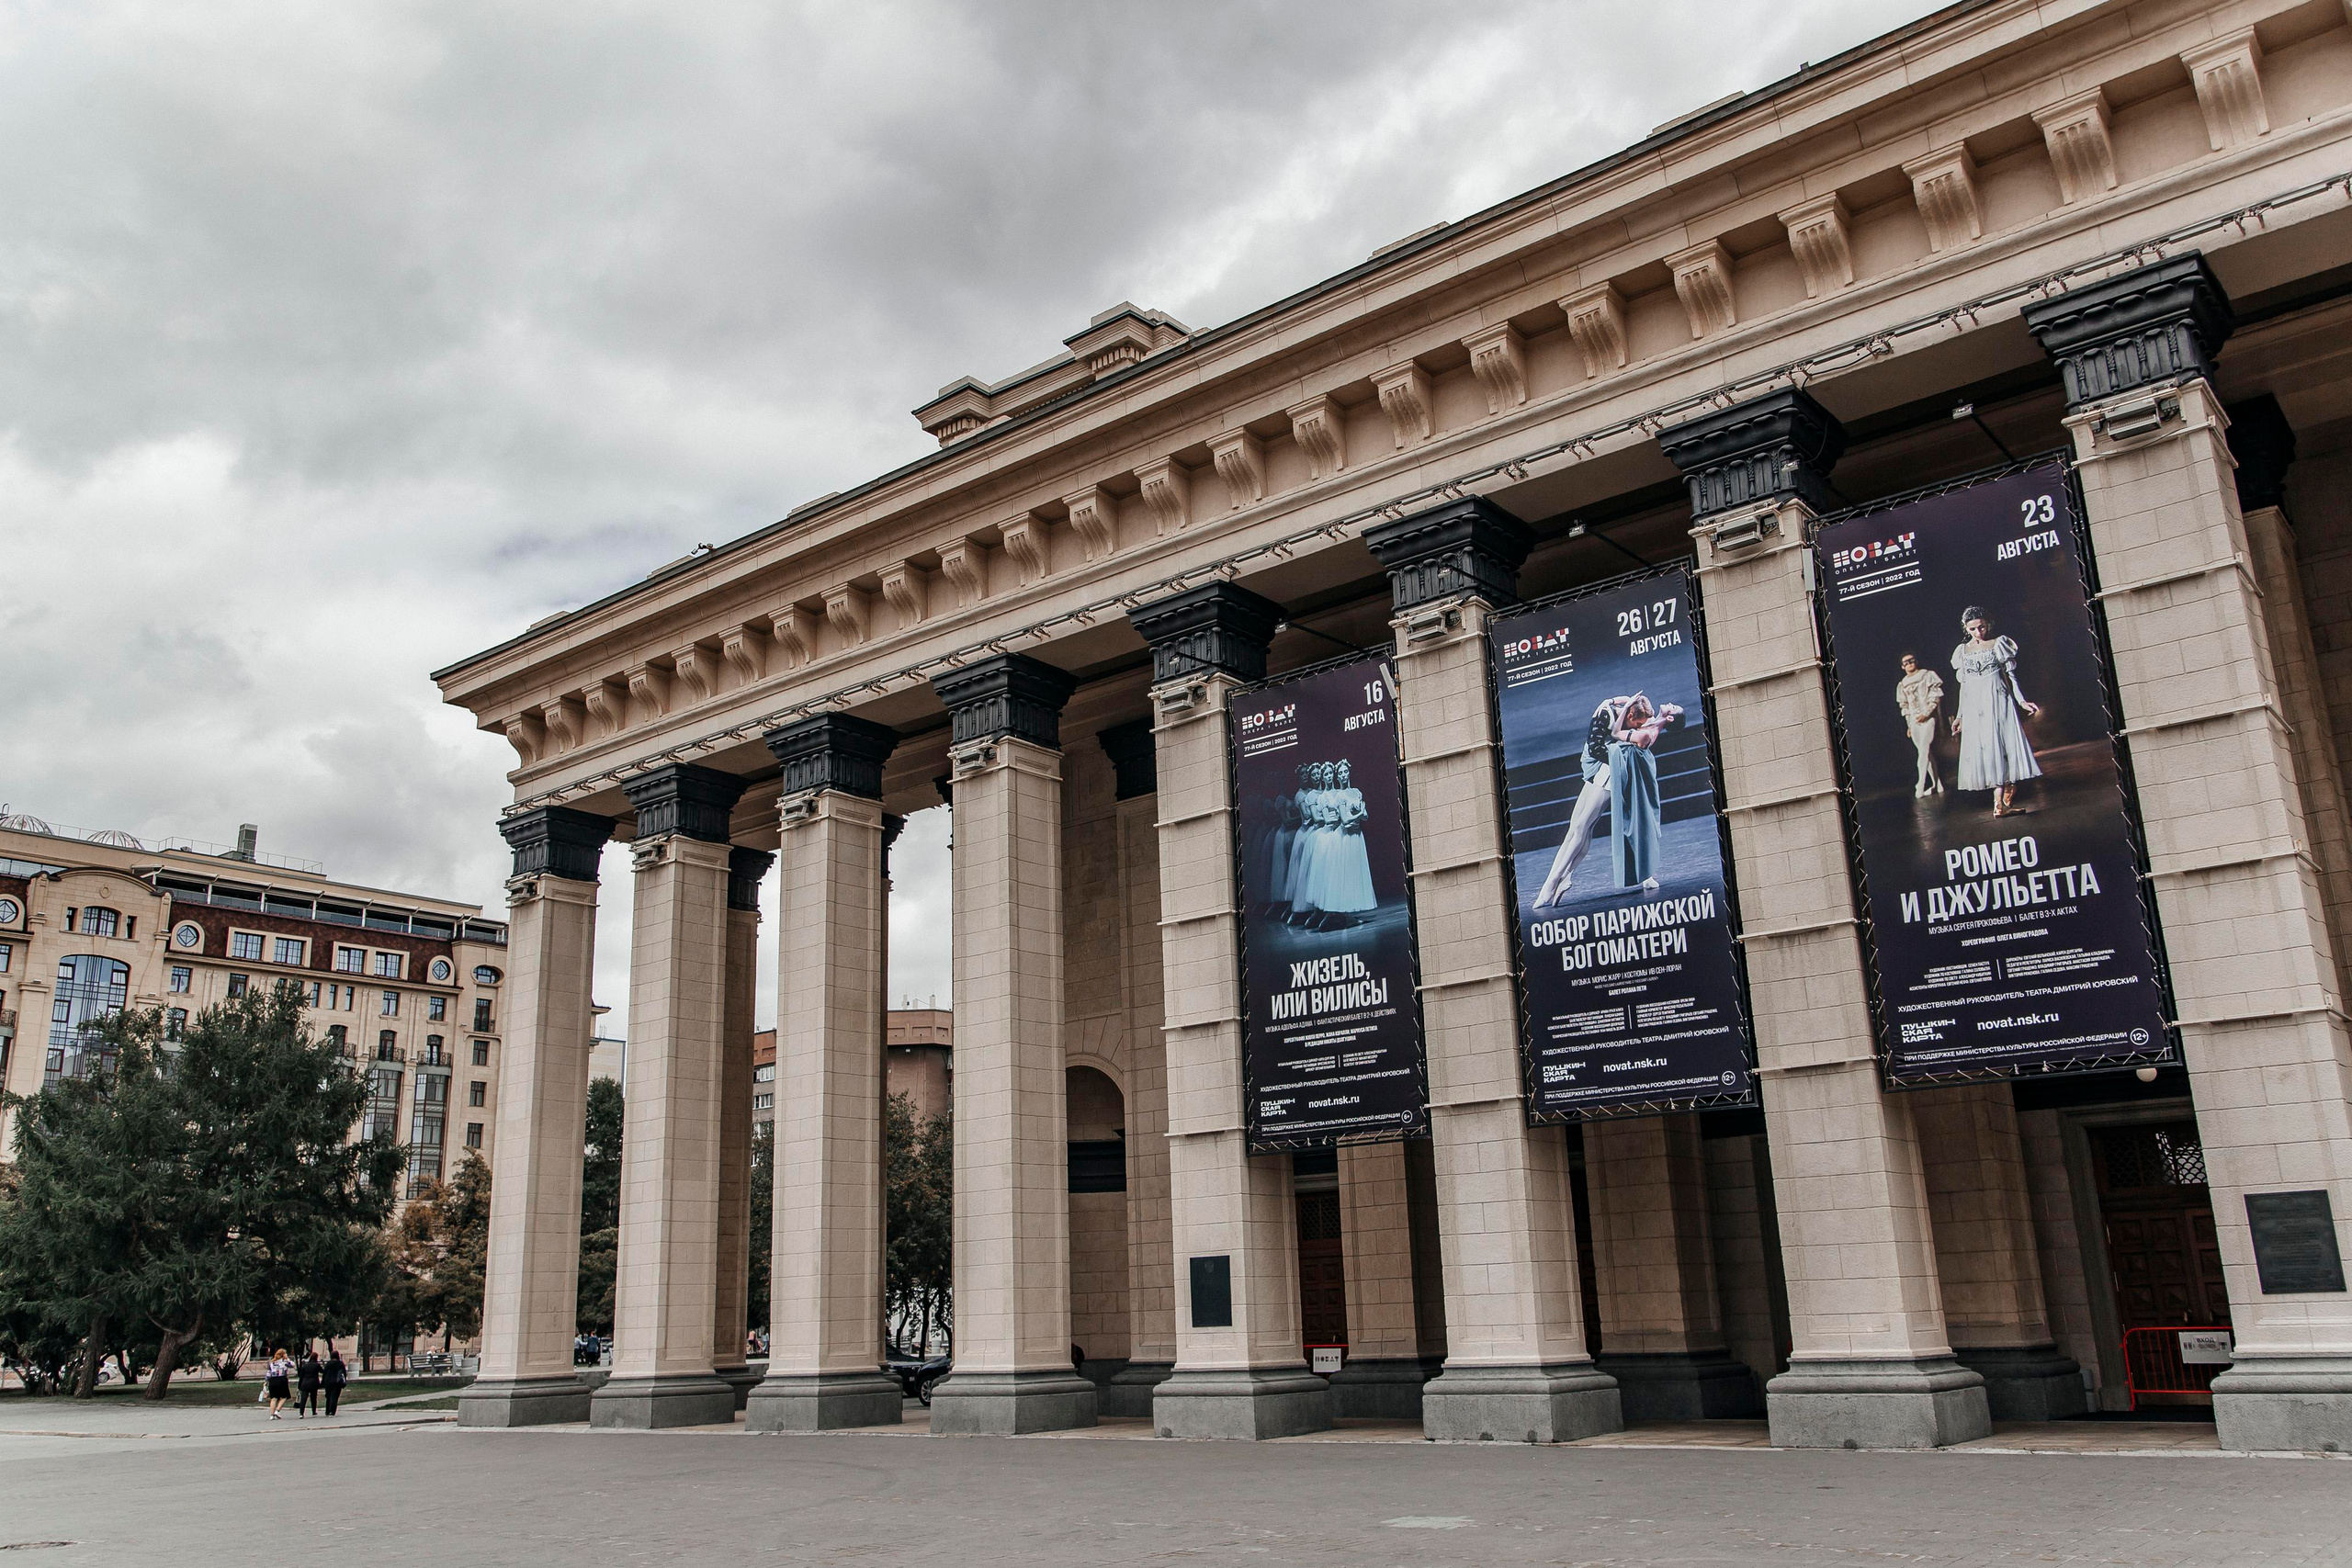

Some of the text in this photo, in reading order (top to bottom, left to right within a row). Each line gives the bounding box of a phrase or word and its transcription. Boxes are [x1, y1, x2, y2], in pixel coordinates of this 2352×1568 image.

[2022, 494, 2054, 527] 23
[1833, 532, 1916, 568] НОВАТ
[1997, 530, 2060, 561] АВГУСТА
[1836, 549, 1917, 574] ОПЕРА БАЛЕТ
[1838, 569, 1920, 594] 77-Й СЕЗОН 2022 ГОД
[1617, 598, 1677, 637] 26 27
[1504, 627, 1570, 658] НОВАТ
[1505, 644, 1570, 663] ОПЕРА БАЛЕТ
[1631, 629, 1681, 656] АВГУСТА
[1508, 672, 1521, 682] 77-Й
[1521, 669, 1540, 678] СЕЗОН
[1544, 664, 1558, 672] 2022
[1364, 680, 1383, 705] 16
[1242, 704, 1295, 729] НОВАТ
[1243, 718, 1295, 735] ОПЕРА БАЛЕТ
[1344, 709, 1385, 731] АВГУСТА
[1944, 836, 2038, 880] РОМЕО
[1900, 863, 2100, 923] И ДЖУЛЬЕТТА
[1531, 888, 1715, 947] СОБОР ПАРИЖСКОЙ
[1928, 906, 2078, 935] МУЗЫКА СЕРГЕЯ ПРОКОФЬЕВА БАЛЕТ В 3-Х АКТАХ
[1563, 928, 1688, 972] БОГОМАТЕРИ
[1962, 929, 2048, 947] ХОРЕОГРАФИЯ ОЛЕГА ВИНОГРАДОВА
[1290, 953, 1370, 988] ЖИЗЕЛЬ,
[1571, 977, 1591, 987] МУЗЫКА
[1592, 975, 1607, 983] МОРИС
[1608, 973, 1621, 981] ЖАРР
[1624, 969, 1647, 979] КОСТЮМЫ
[1657, 964, 1682, 974] СЕН-ЛОРАН
[1272, 978, 1387, 1020] ИЛИ ВИЛИСЫ
[1898, 998, 1965, 1012] ХУДОЖЕСТВЕННЫЙ
[1966, 991, 2024, 1004] РУКОВОДИТЕЛЬ
[2053, 982, 2091, 995] ДМИТРИЙ
[2093, 976, 2138, 988] ЮРОВСКИЙ
[1901, 1019, 1956, 1031] ПУШКИН
[1902, 1028, 1933, 1036] СКАЯ
[1976, 1012, 2059, 1031] novat.nsk.ru
[1542, 1026, 1729, 1055] ХУДОЖЕСТВЕННЫЙ РУКОВОДИТЕЛЬ ТЕАТРА ДМИТРИЙ ЮРОВСКИЙ
[1903, 1033, 1943, 1043] КАРТА
[1917, 1051, 1955, 1060] ПОДДЕРЖКЕ
[1956, 1046, 2006, 1056] МИНИСТЕРСТВА
[2007, 1042, 2039, 1051] КУЛЬТУРЫ
[2040, 1036, 2085, 1046] РОССИЙСКОЙ
[2086, 1032, 2127, 1042] ФЕДЕРАЦИИ
[1544, 1062, 1586, 1071] ПУШКИН
[1603, 1058, 1668, 1073] novat.nsk.ru
[1261, 1083, 1303, 1092] ХУДОЖЕСТВЕННЫЙ
[1304, 1078, 1340, 1088] РУКОВОДИТЕЛЬ
[1357, 1072, 1381, 1081] ДМИТРИЙ
[1544, 1075, 1576, 1083] КАРТА
[1555, 1089, 1584, 1098] ПОДДЕРЖКЕ
[1585, 1086, 1624, 1095] МИНИСТЕРСТВА
[1624, 1083, 1649, 1091] КУЛЬТУРЫ
[1651, 1079, 1686, 1088] РОССИЙСКОЙ
[1687, 1076, 1718, 1084] ФЕДЕРАЦИИ
[1261, 1099, 1295, 1107] ПУШКИН
[1308, 1095, 1360, 1108] novat.nsk.ru
[1294, 1121, 1325, 1129] МИНИСТЕРСТВА
[1346, 1115, 1374, 1123] РОССИЙСКОЙ
